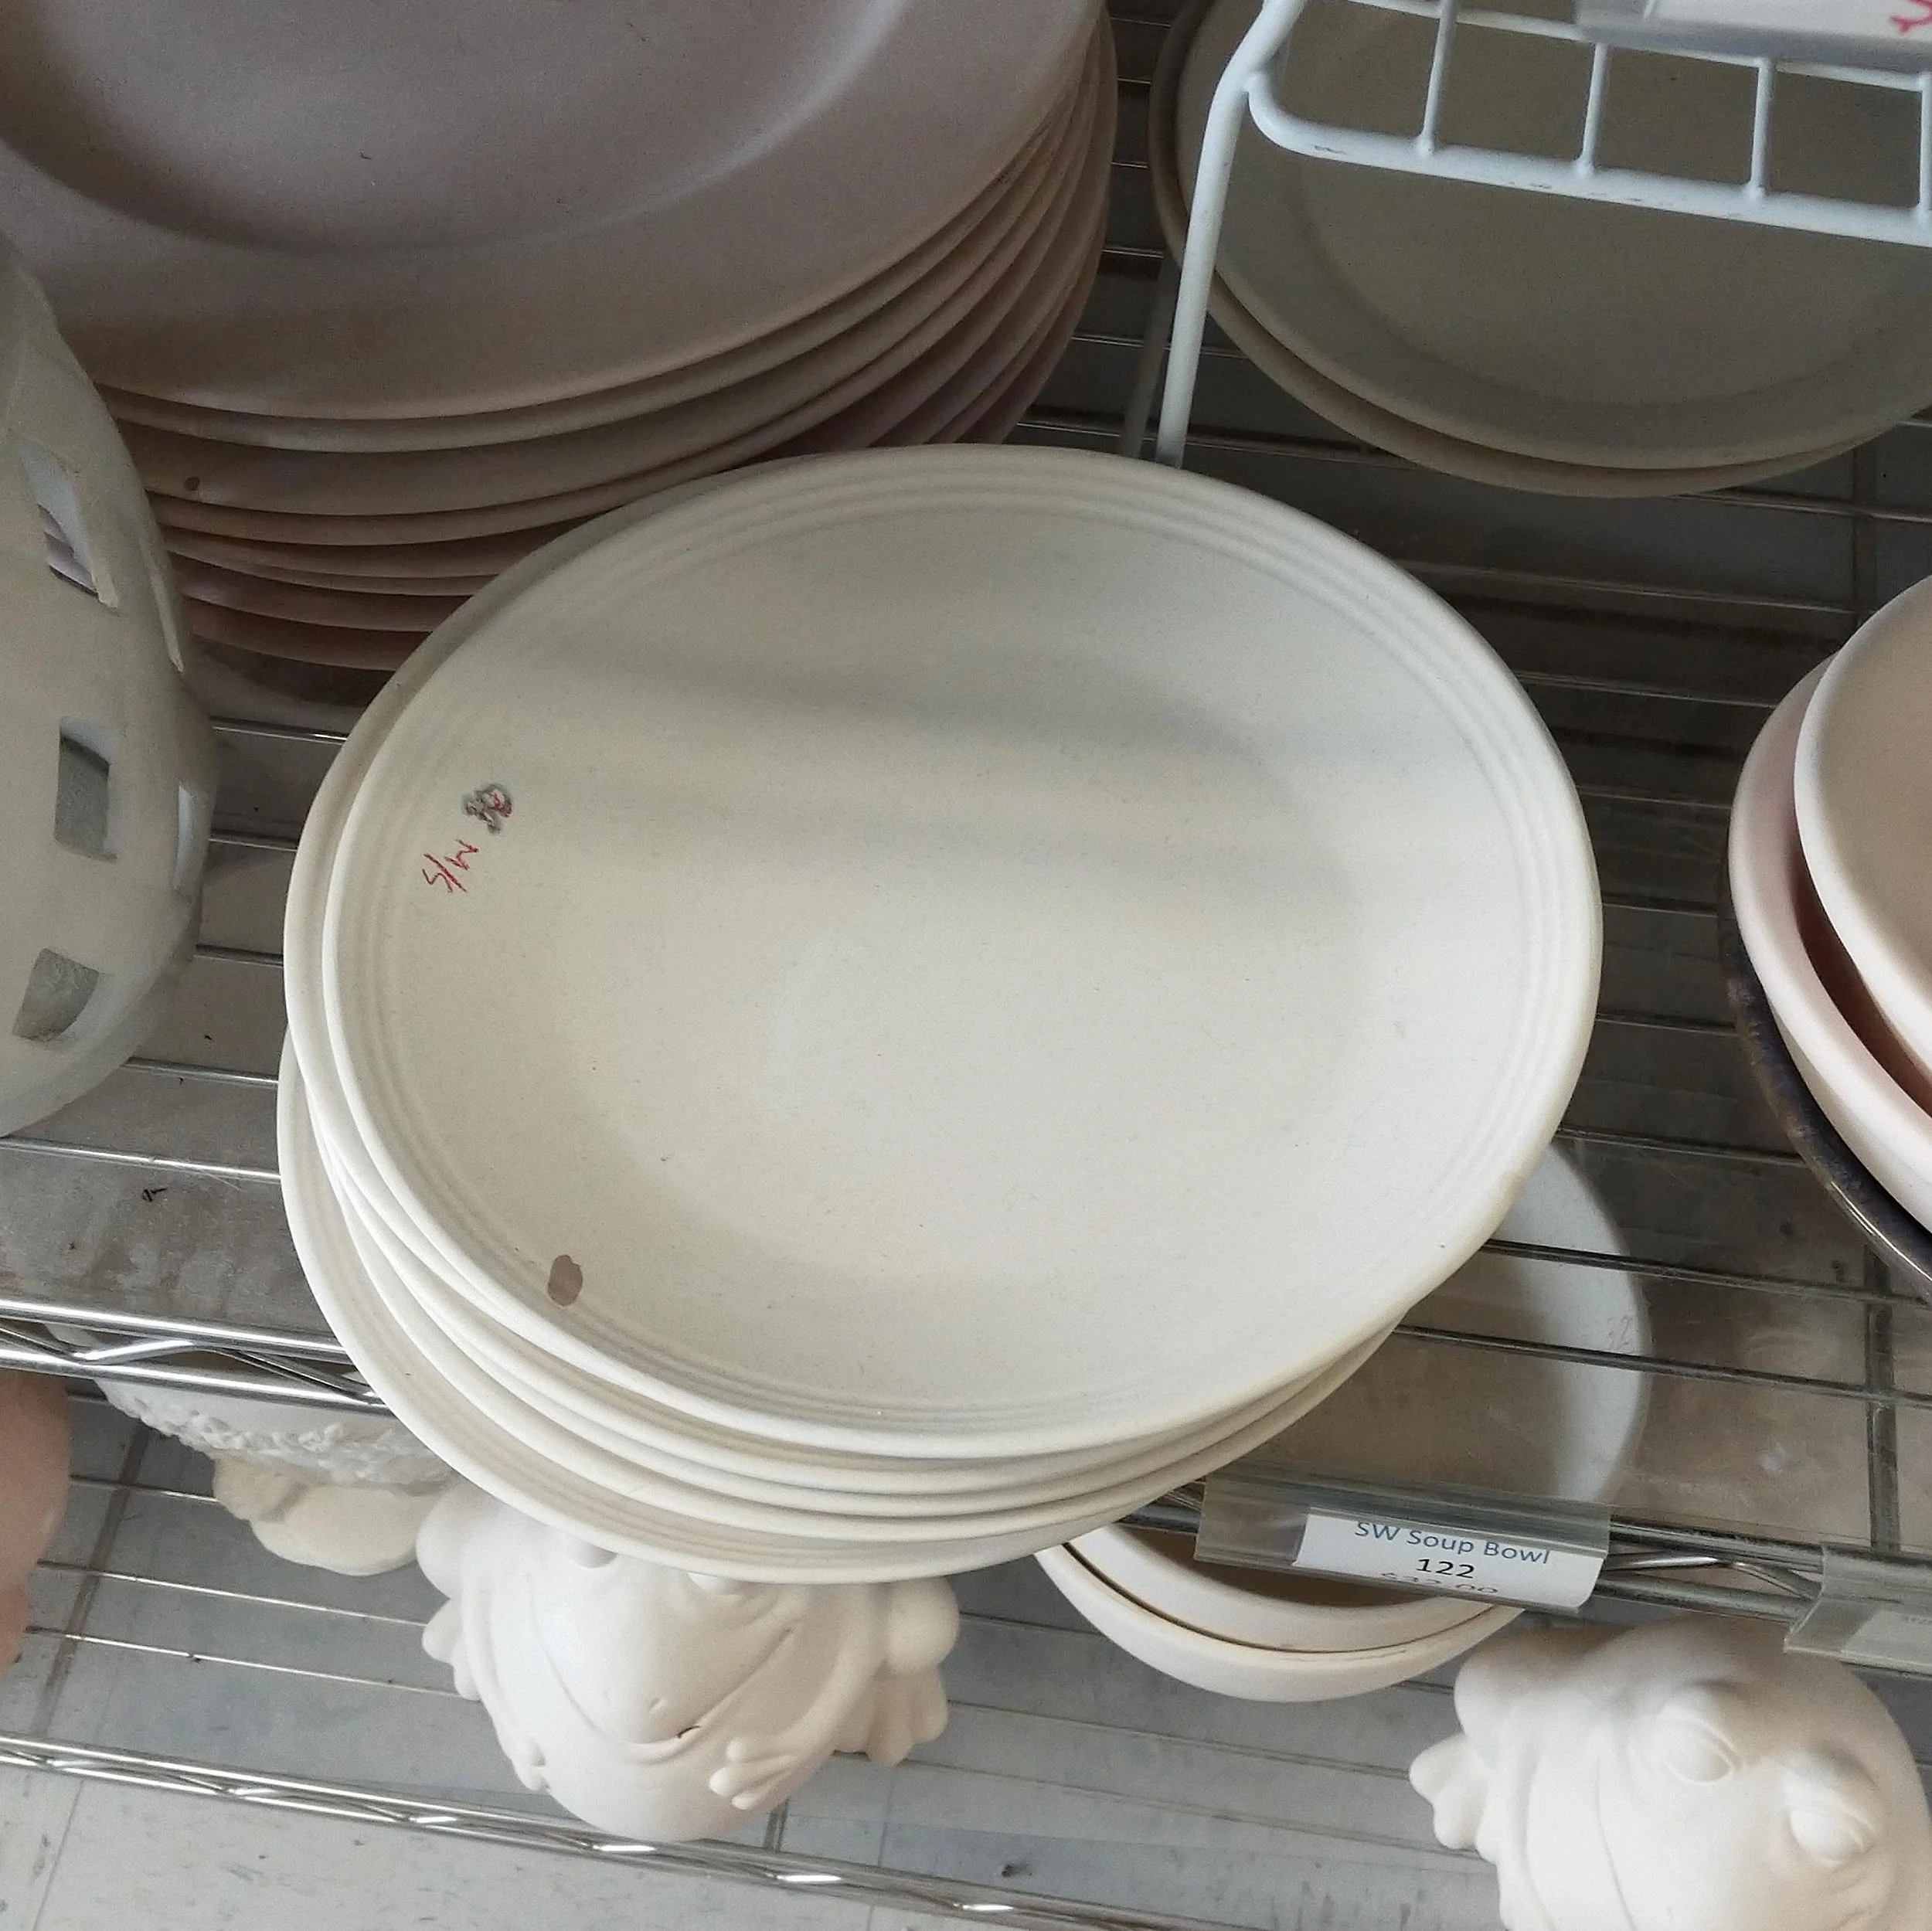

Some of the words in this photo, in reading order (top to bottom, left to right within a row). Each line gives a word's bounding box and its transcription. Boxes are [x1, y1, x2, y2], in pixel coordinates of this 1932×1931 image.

[1355, 1522, 1401, 1541] SW
[1406, 1530, 1475, 1555] Soup
[1484, 1542, 1550, 1564] Bowl
[1416, 1558, 1475, 1579] 122
